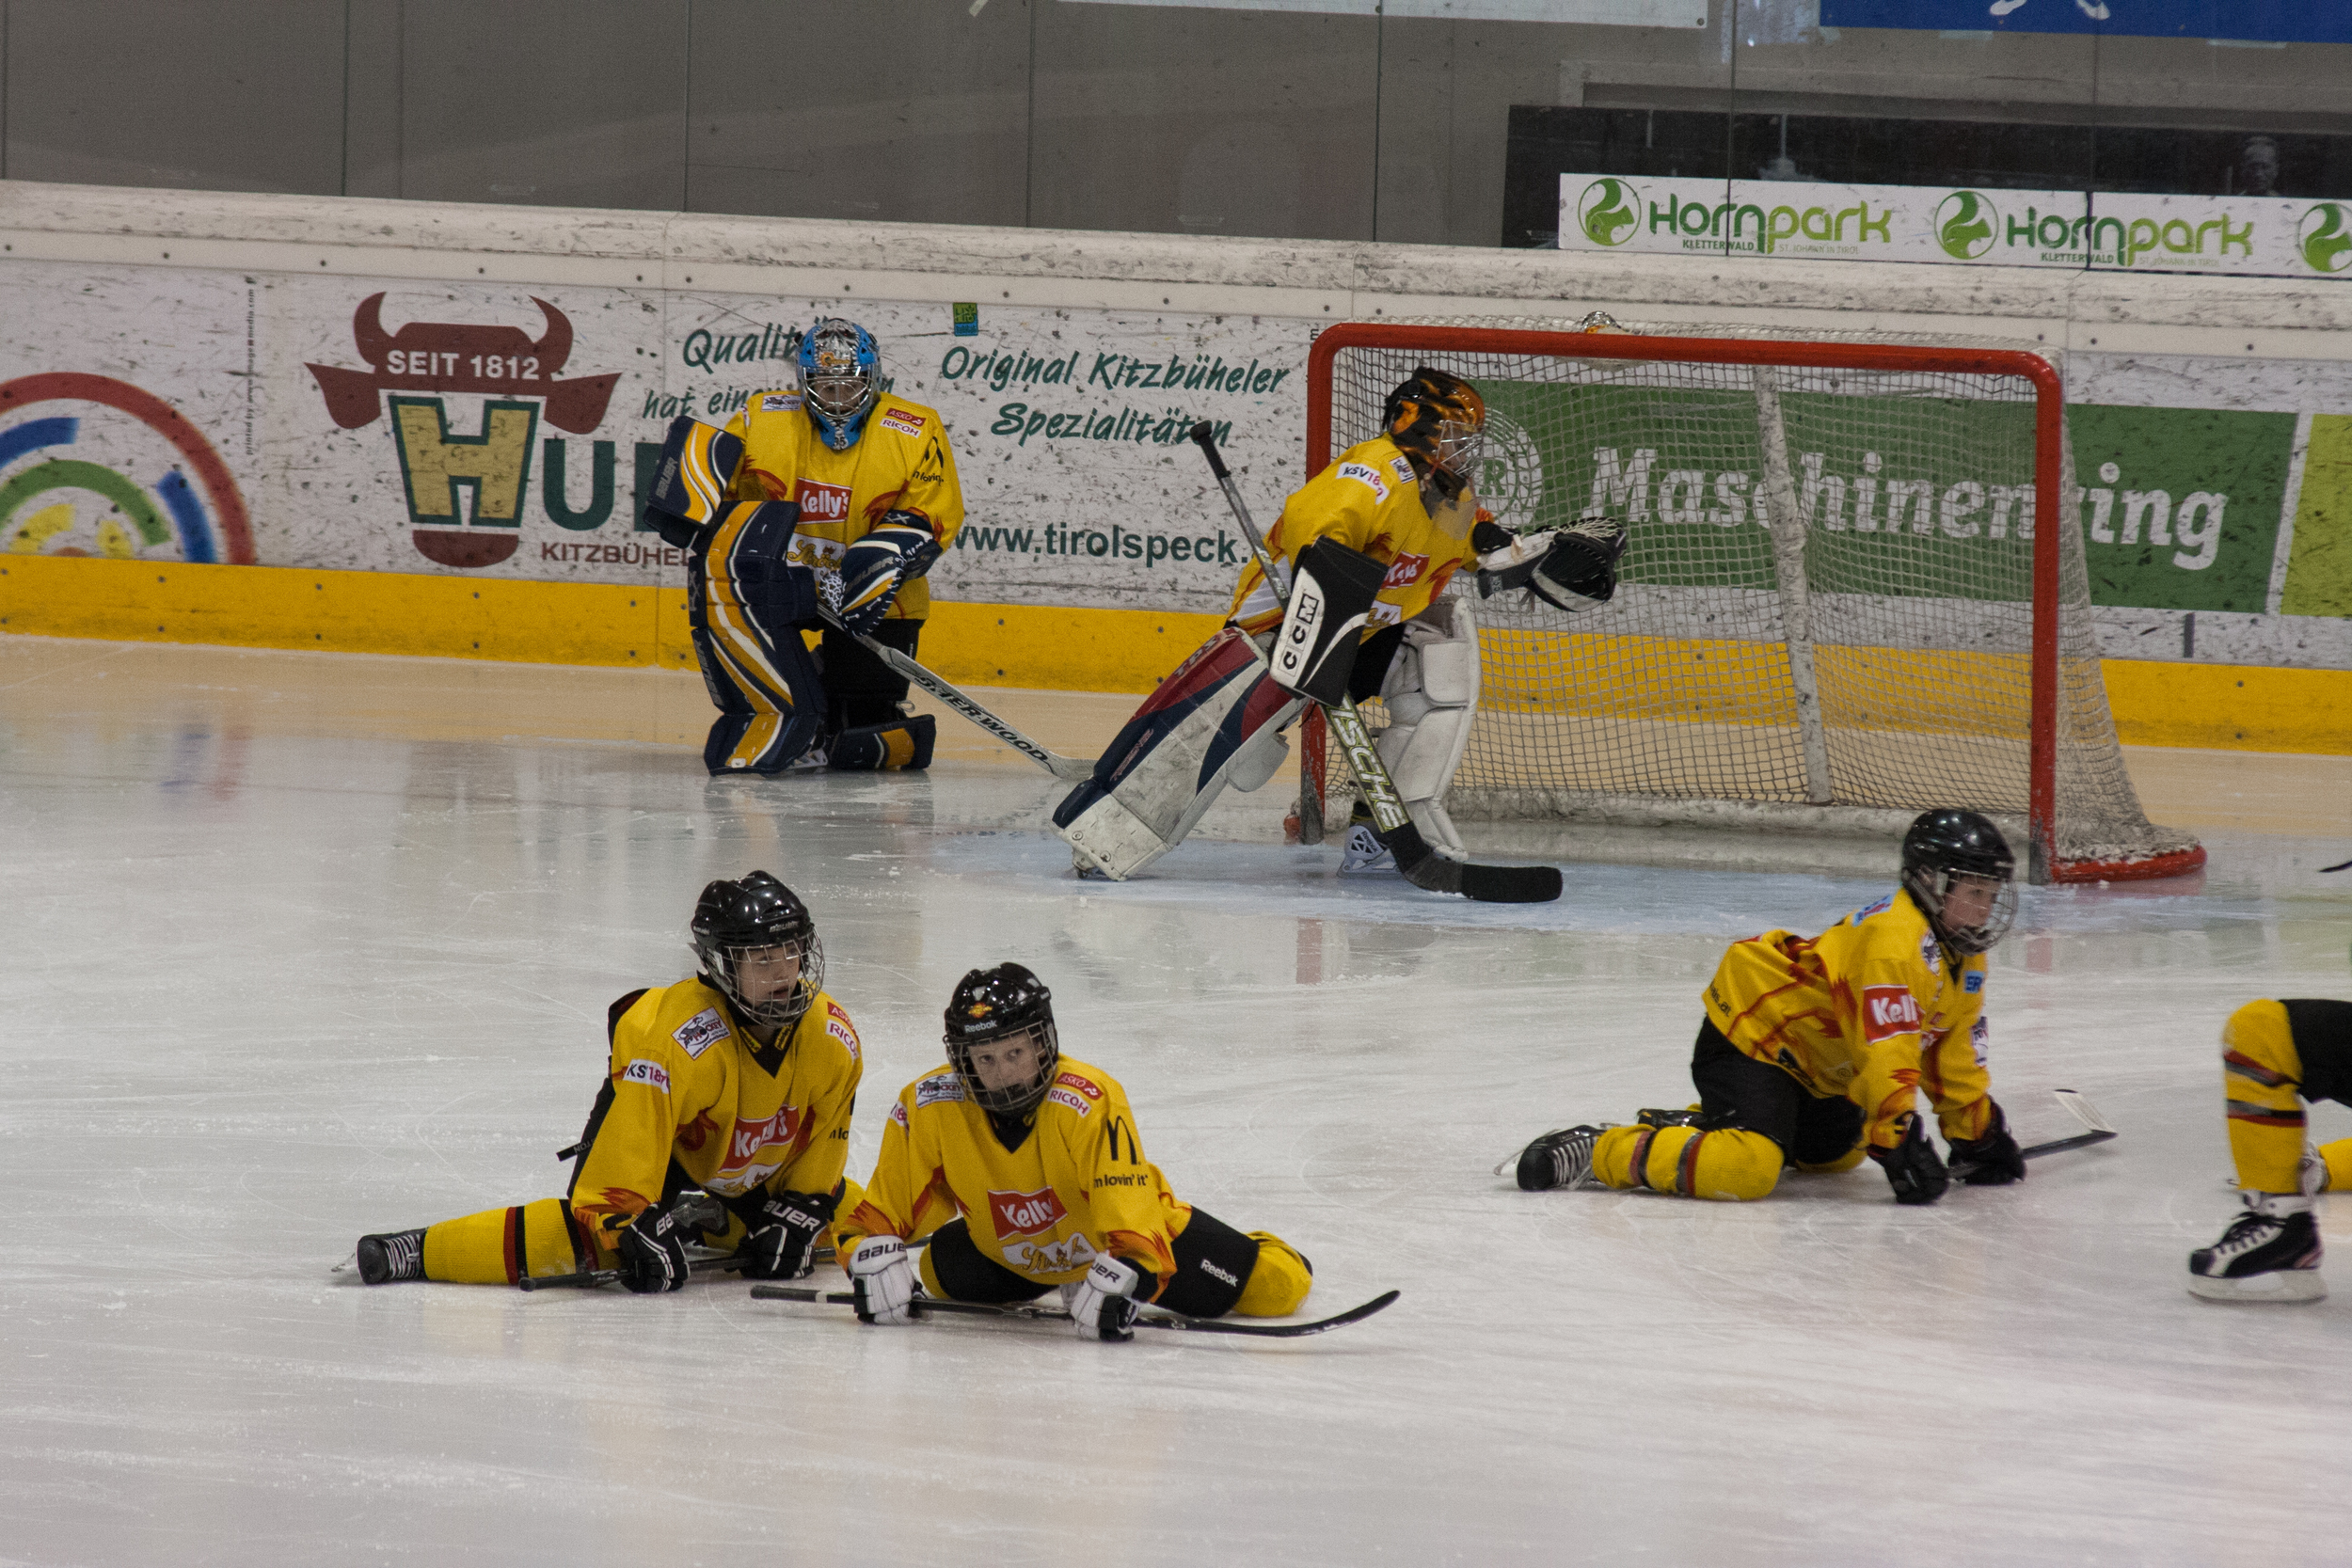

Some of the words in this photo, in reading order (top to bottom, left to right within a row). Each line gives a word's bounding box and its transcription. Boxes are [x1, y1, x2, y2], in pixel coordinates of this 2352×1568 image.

[1649, 193, 1892, 254] Hornpark
[2007, 206, 2254, 267] Hornpark
[683, 316, 828, 374] Qualit
[387, 349, 460, 376] SEIT
[469, 355, 540, 381] 1812
[941, 346, 1080, 392] Original
[1088, 351, 1291, 393] Kitzbüheler
[642, 388, 696, 420] hat
[889, 410, 913, 421] ASKO
[882, 419, 919, 436] RICOH
[991, 403, 1232, 447] Spezialitätn
[1283, 594, 1319, 672] CCM
[964, 1020, 997, 1034] Reebok
[1060, 1074, 1087, 1088] ASKO
[1050, 1089, 1089, 1116] RICOH
[762, 1199, 820, 1232] AUER
[857, 1243, 905, 1263] BAUE
[1200, 1259, 1238, 1288] Reebok
